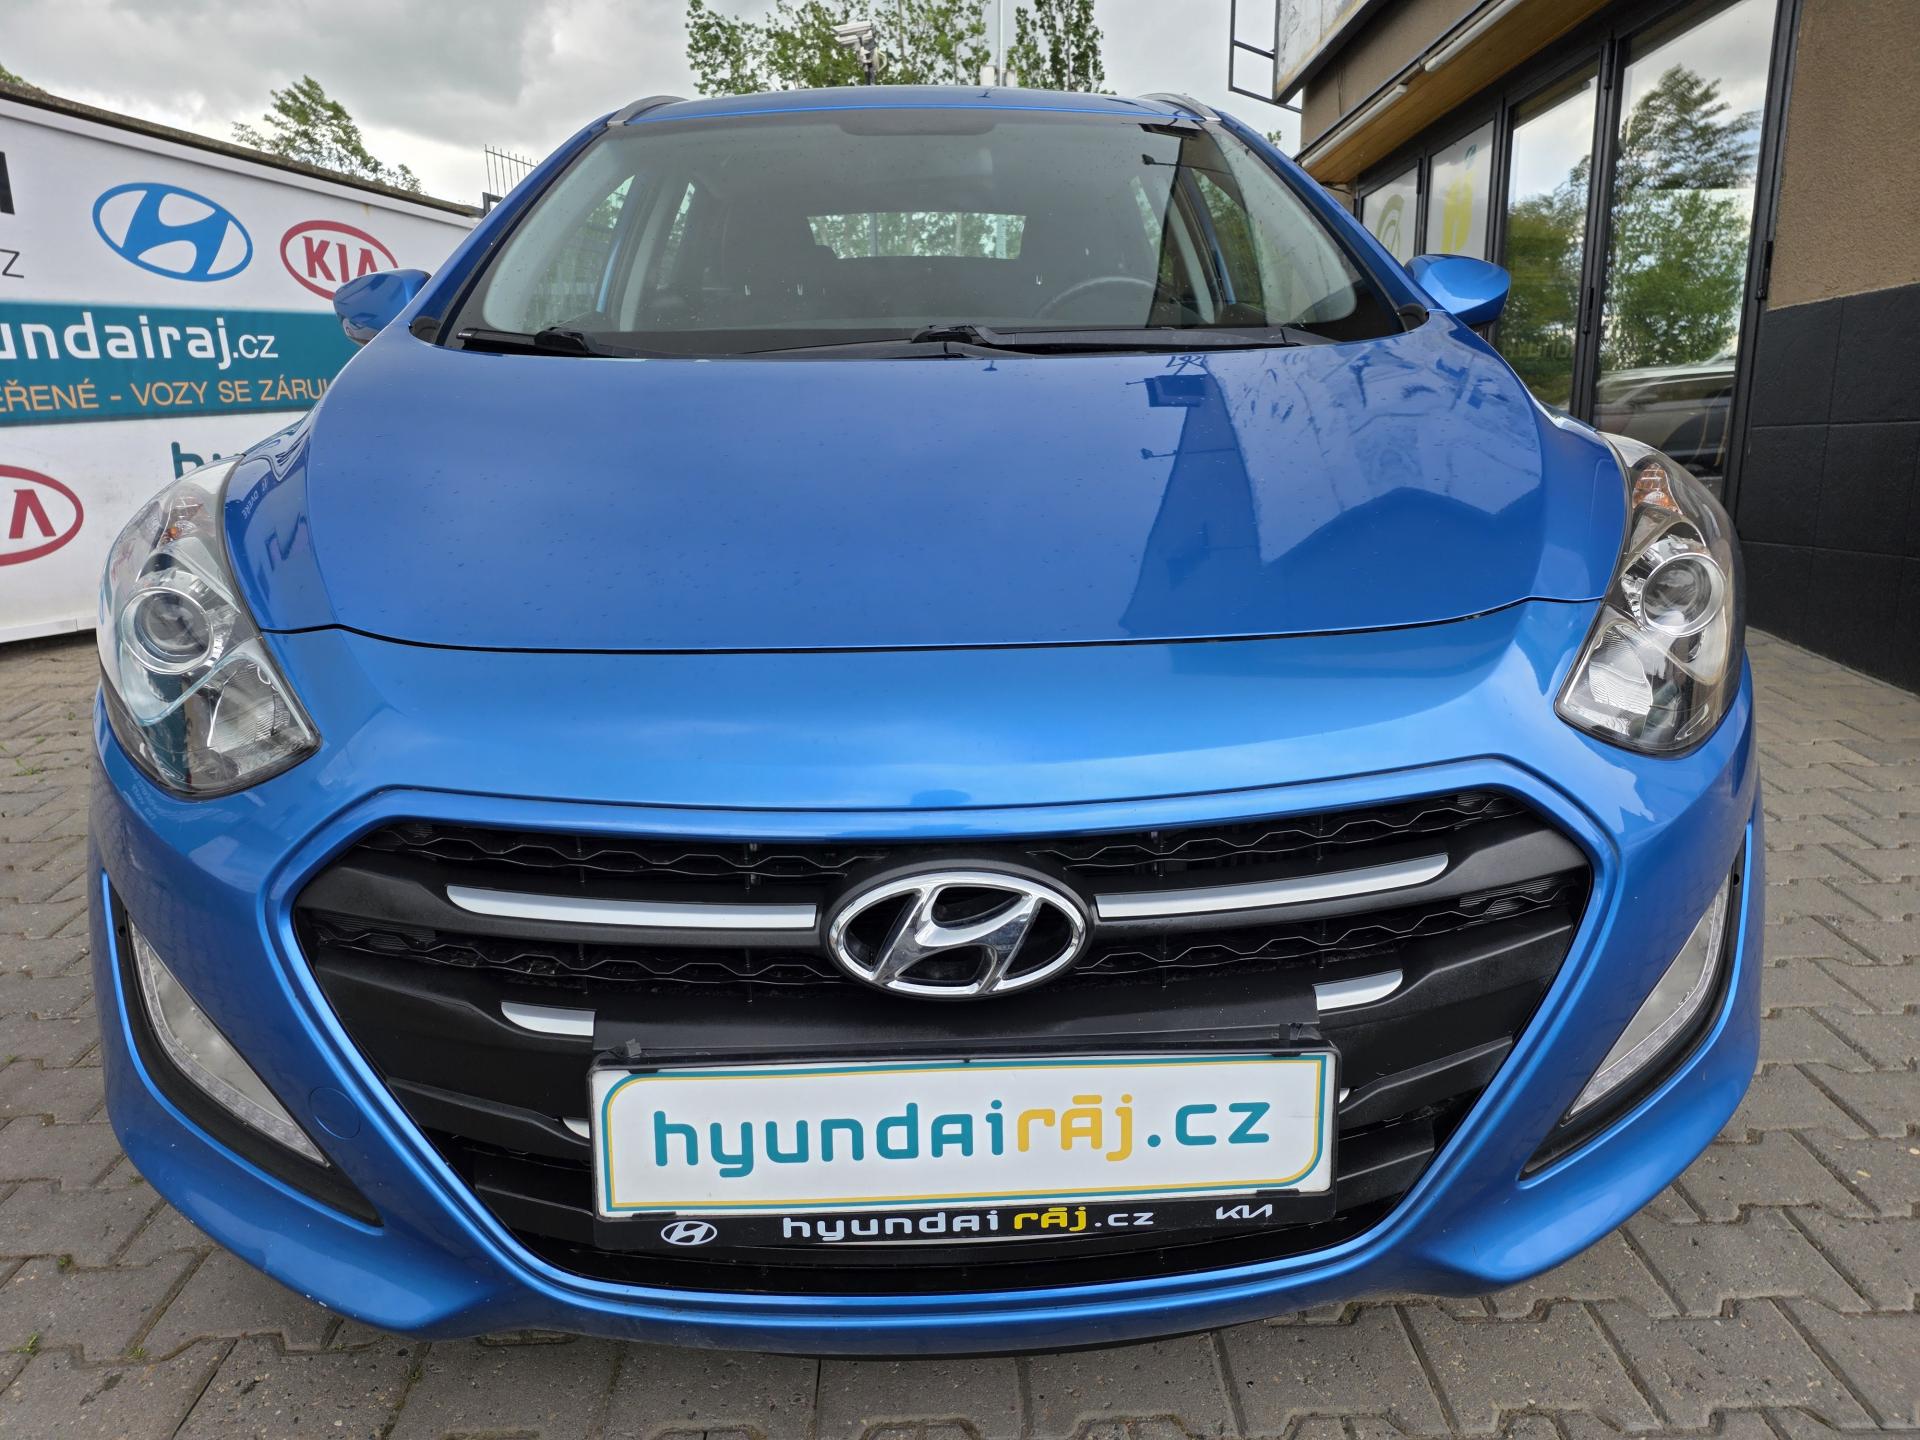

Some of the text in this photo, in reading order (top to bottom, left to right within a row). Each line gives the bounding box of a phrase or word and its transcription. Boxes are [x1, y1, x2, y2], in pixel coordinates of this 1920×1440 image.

[302, 235, 378, 284] KIA
[0, 377, 99, 412] ŘENÉ
[130, 381, 208, 407] VOZY
[218, 380, 252, 404] SE
[258, 374, 330, 401] ZÁRU
